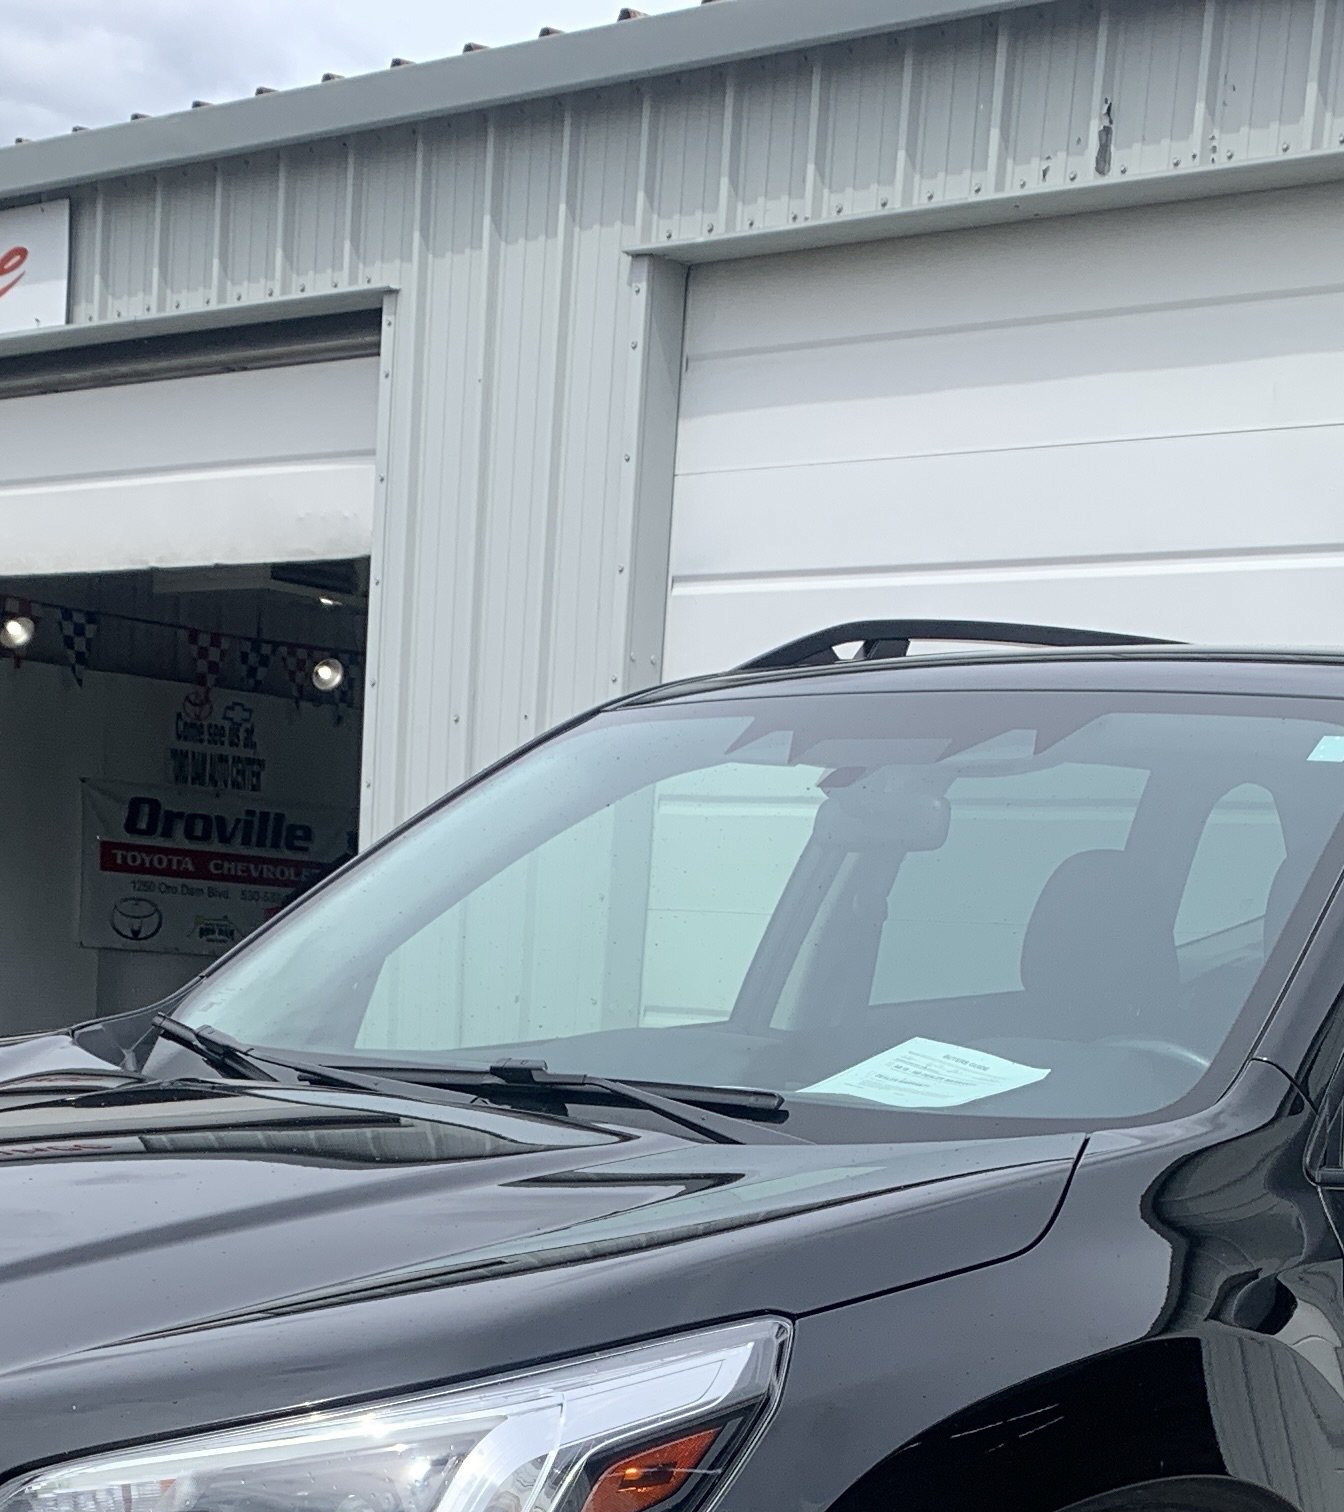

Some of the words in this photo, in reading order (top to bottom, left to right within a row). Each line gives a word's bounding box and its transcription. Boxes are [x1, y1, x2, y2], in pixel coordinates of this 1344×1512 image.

[176, 712, 205, 744] Come
[207, 722, 226, 746] see
[125, 796, 312, 852] Oroville
[114, 850, 195, 872] TOYOTA
[158, 881, 178, 895] Oro
[181, 883, 204, 897] Dam
